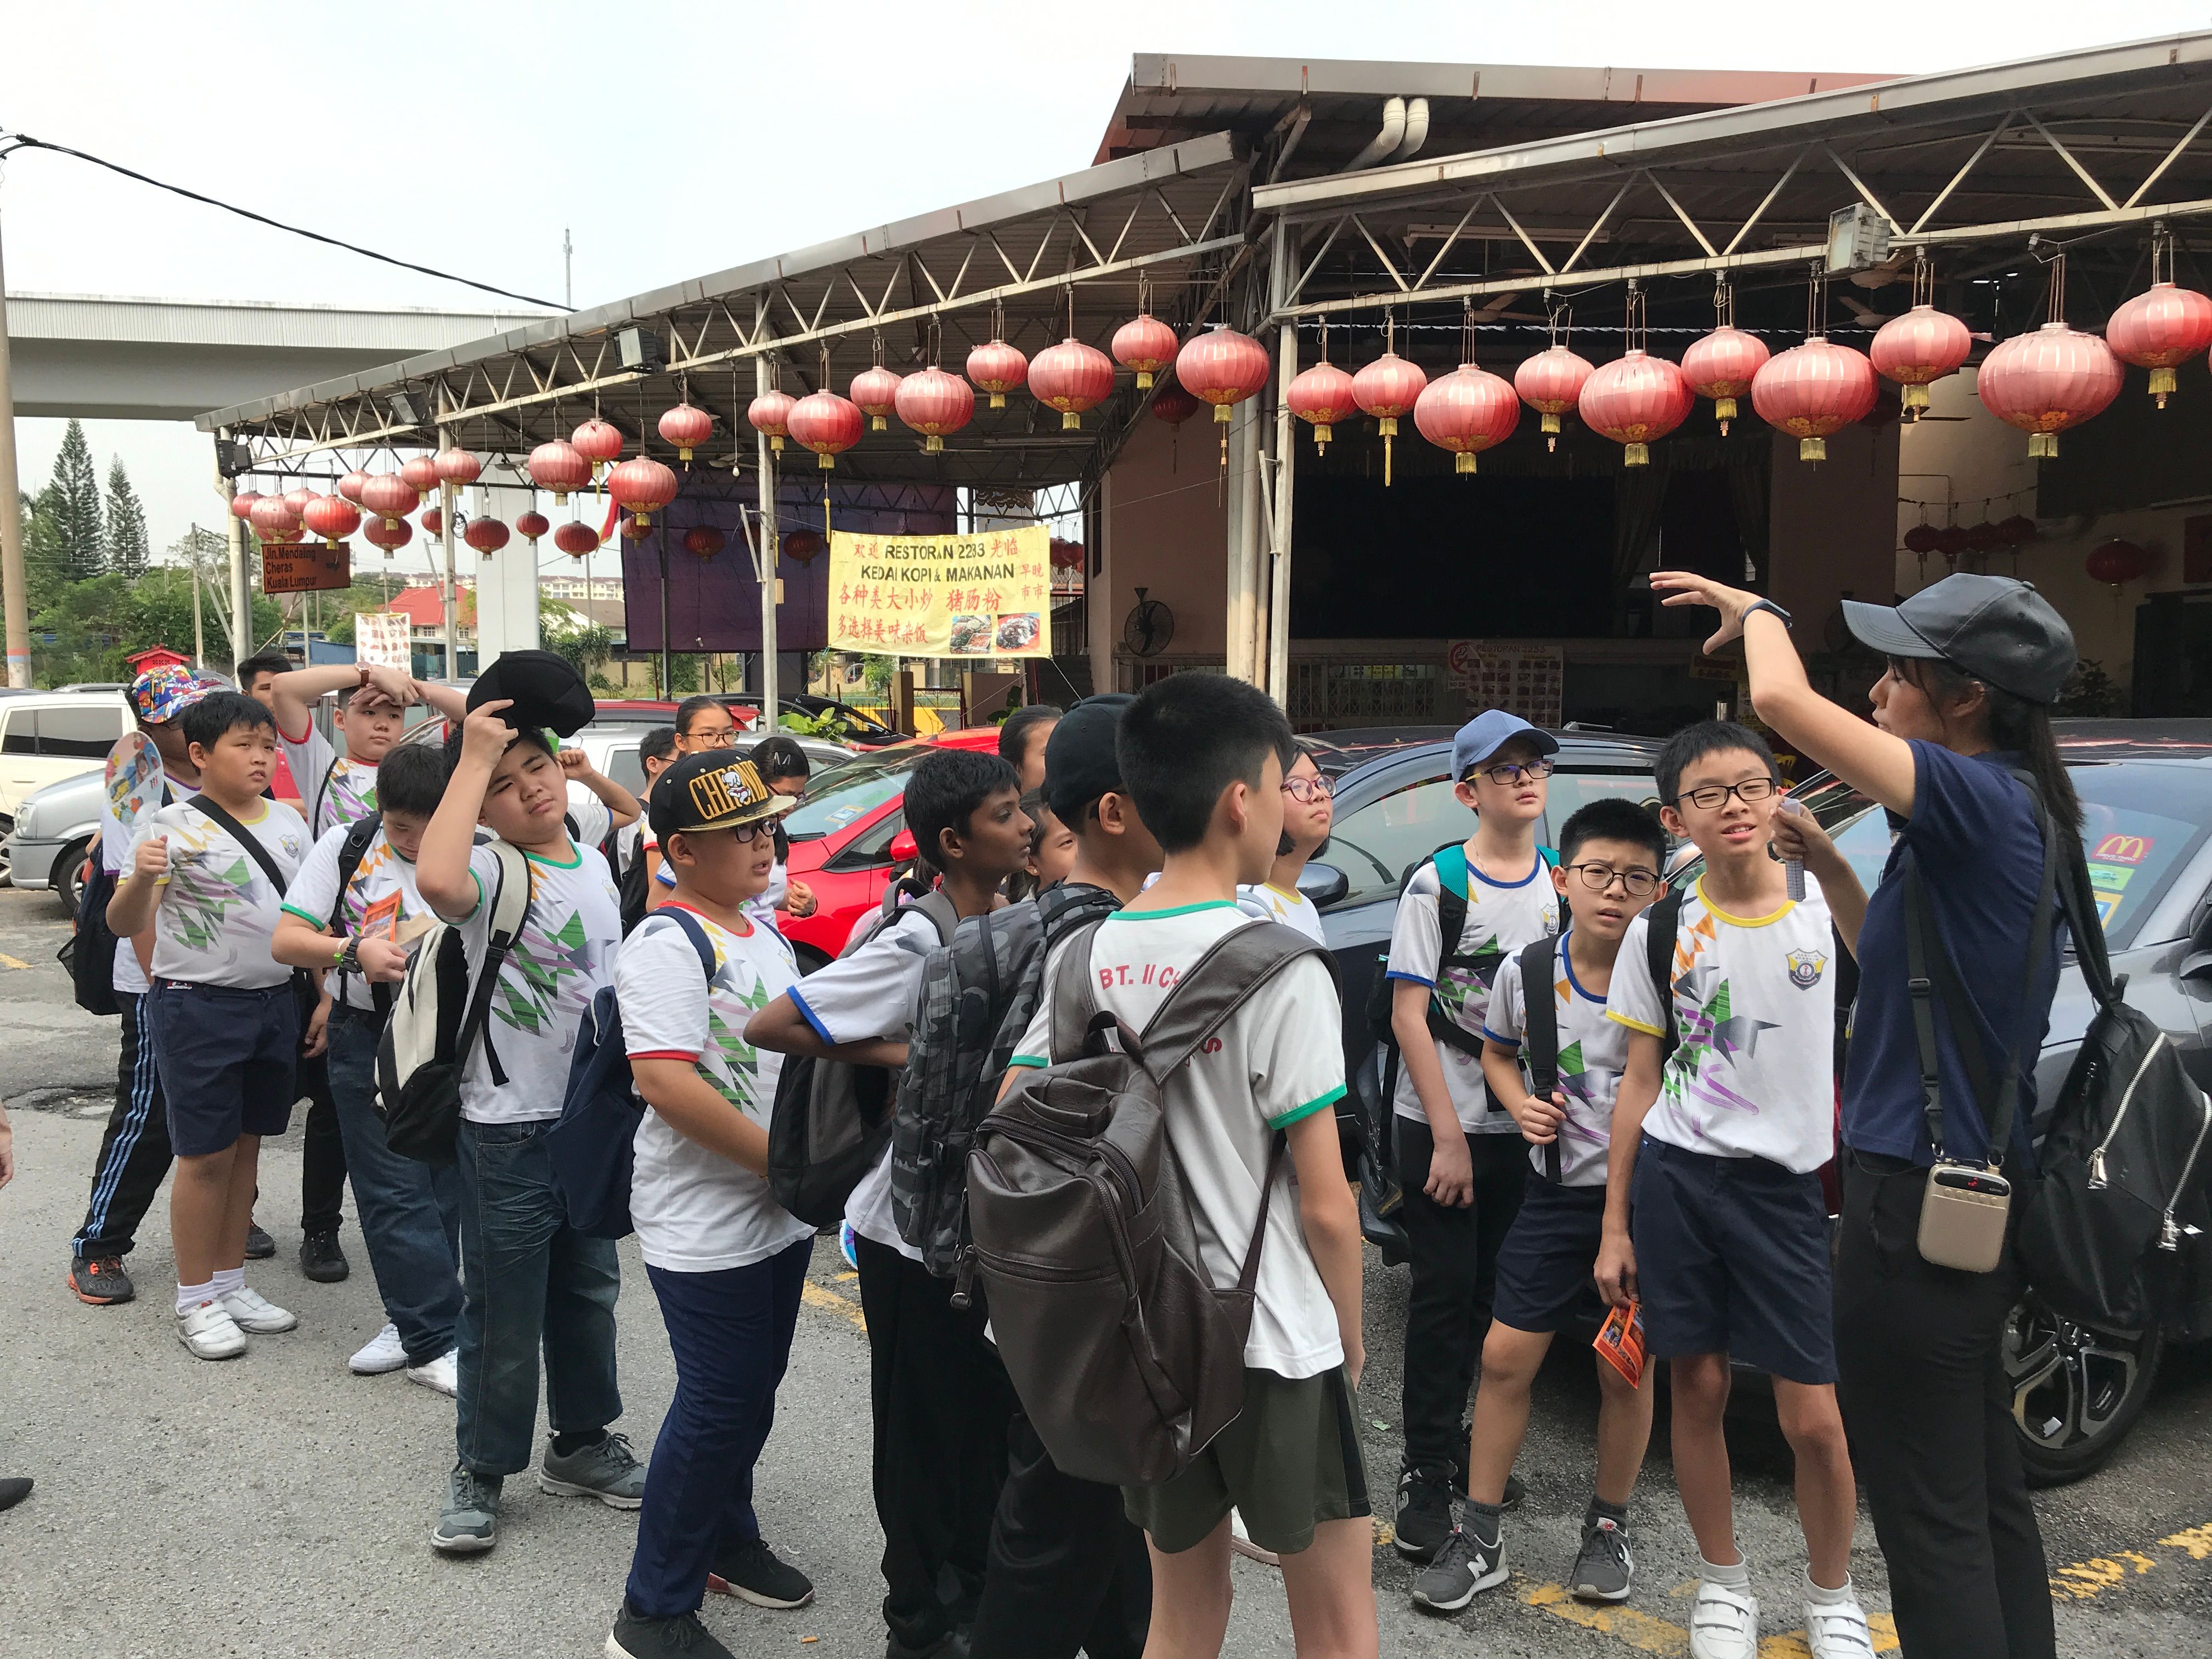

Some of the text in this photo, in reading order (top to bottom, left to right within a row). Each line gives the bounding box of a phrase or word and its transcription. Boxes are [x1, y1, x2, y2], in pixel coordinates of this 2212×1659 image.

[885, 543, 985, 560] RESTORAN 2233
[990, 537, 1018, 558] 光临
[266, 562, 294, 574] Cheras
[861, 563, 1014, 582] KEDAI KOPI & MAKANAN
[267, 575, 317, 589] Kuala Lumpur
[945, 588, 1002, 613] 猪肠粉
[837, 613, 929, 645] 多选择美味杂饭
[1099, 964, 1134, 990] BT.
